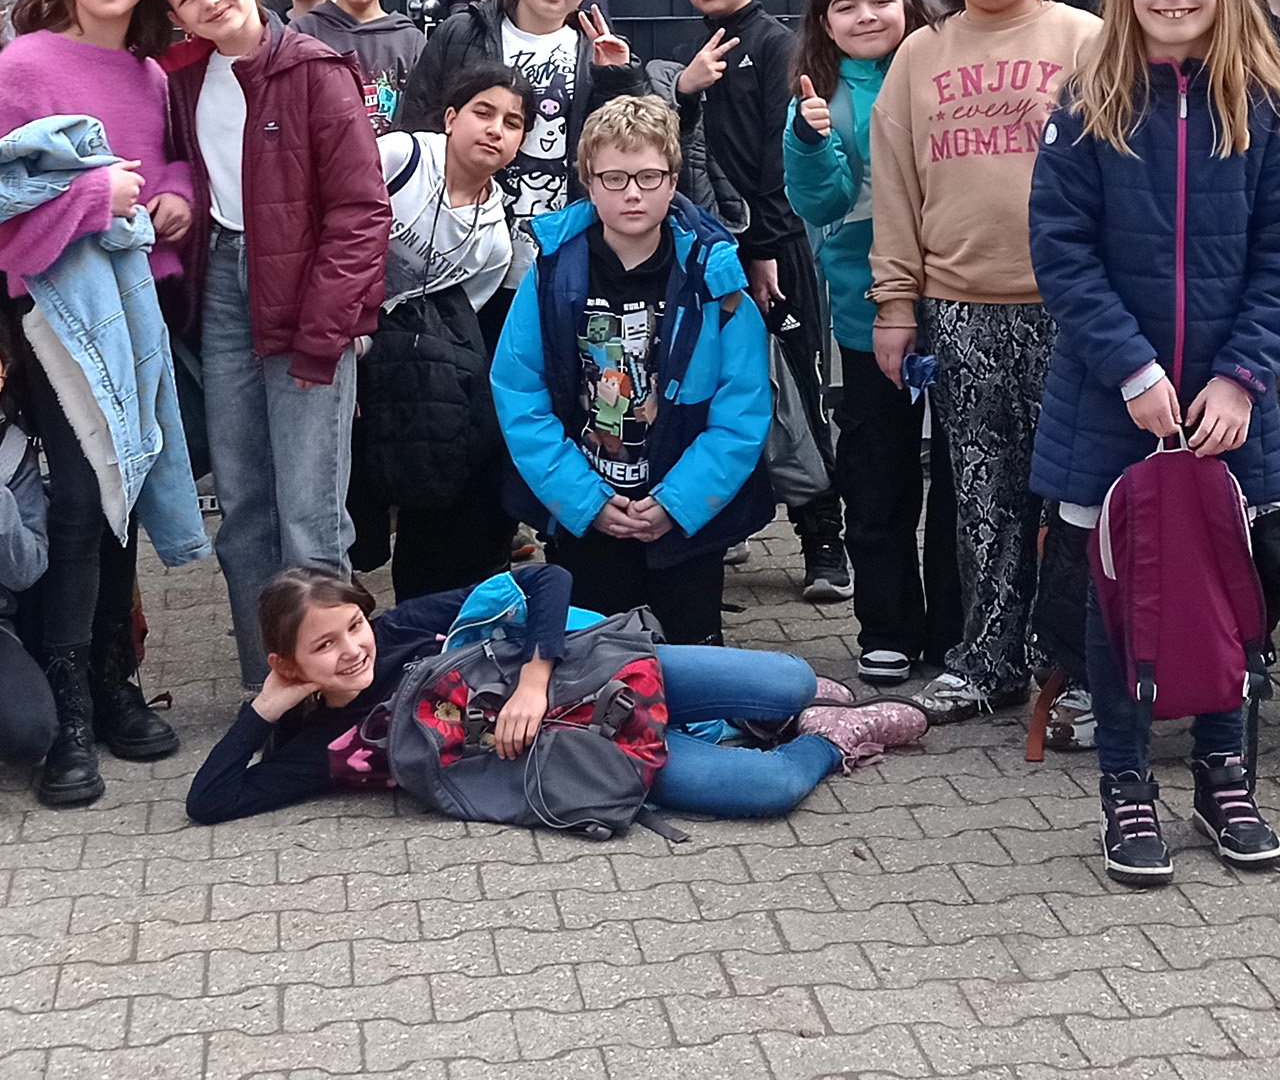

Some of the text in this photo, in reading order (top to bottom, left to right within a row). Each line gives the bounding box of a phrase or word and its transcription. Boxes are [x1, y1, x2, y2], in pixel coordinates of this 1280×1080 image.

[933, 60, 1063, 105] ENJOY
[953, 98, 1038, 134] every
[930, 119, 1044, 162] MOMEN
